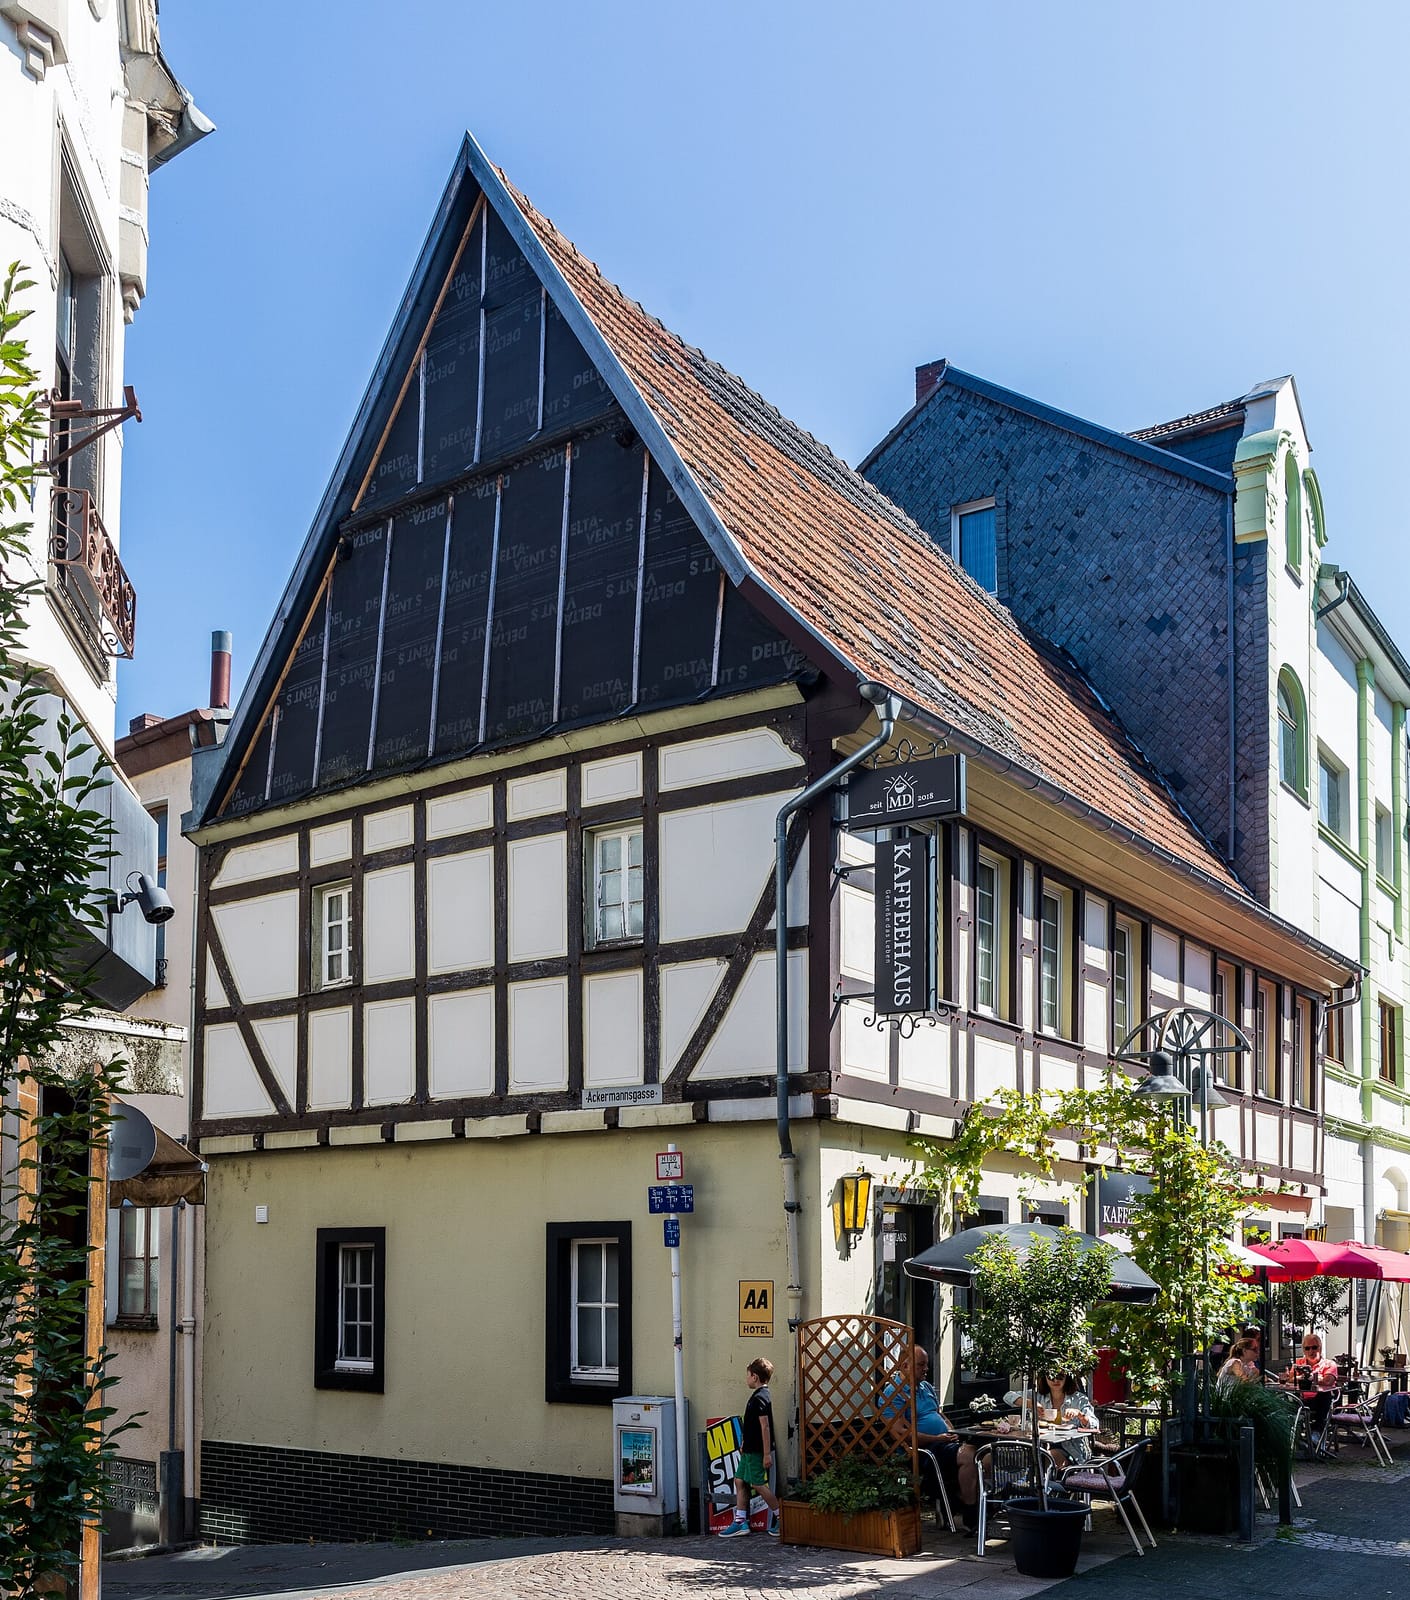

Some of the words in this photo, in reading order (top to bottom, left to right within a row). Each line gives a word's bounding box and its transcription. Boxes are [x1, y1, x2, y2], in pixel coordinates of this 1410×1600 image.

[870, 802, 882, 810] seit
[889, 794, 912, 809] MD
[894, 842, 911, 1007] KAFFEEHAUS
[588, 1090, 655, 1103] Ackermannsgasse
[743, 1289, 768, 1310] AA
[743, 1325, 770, 1334] HOTEL
